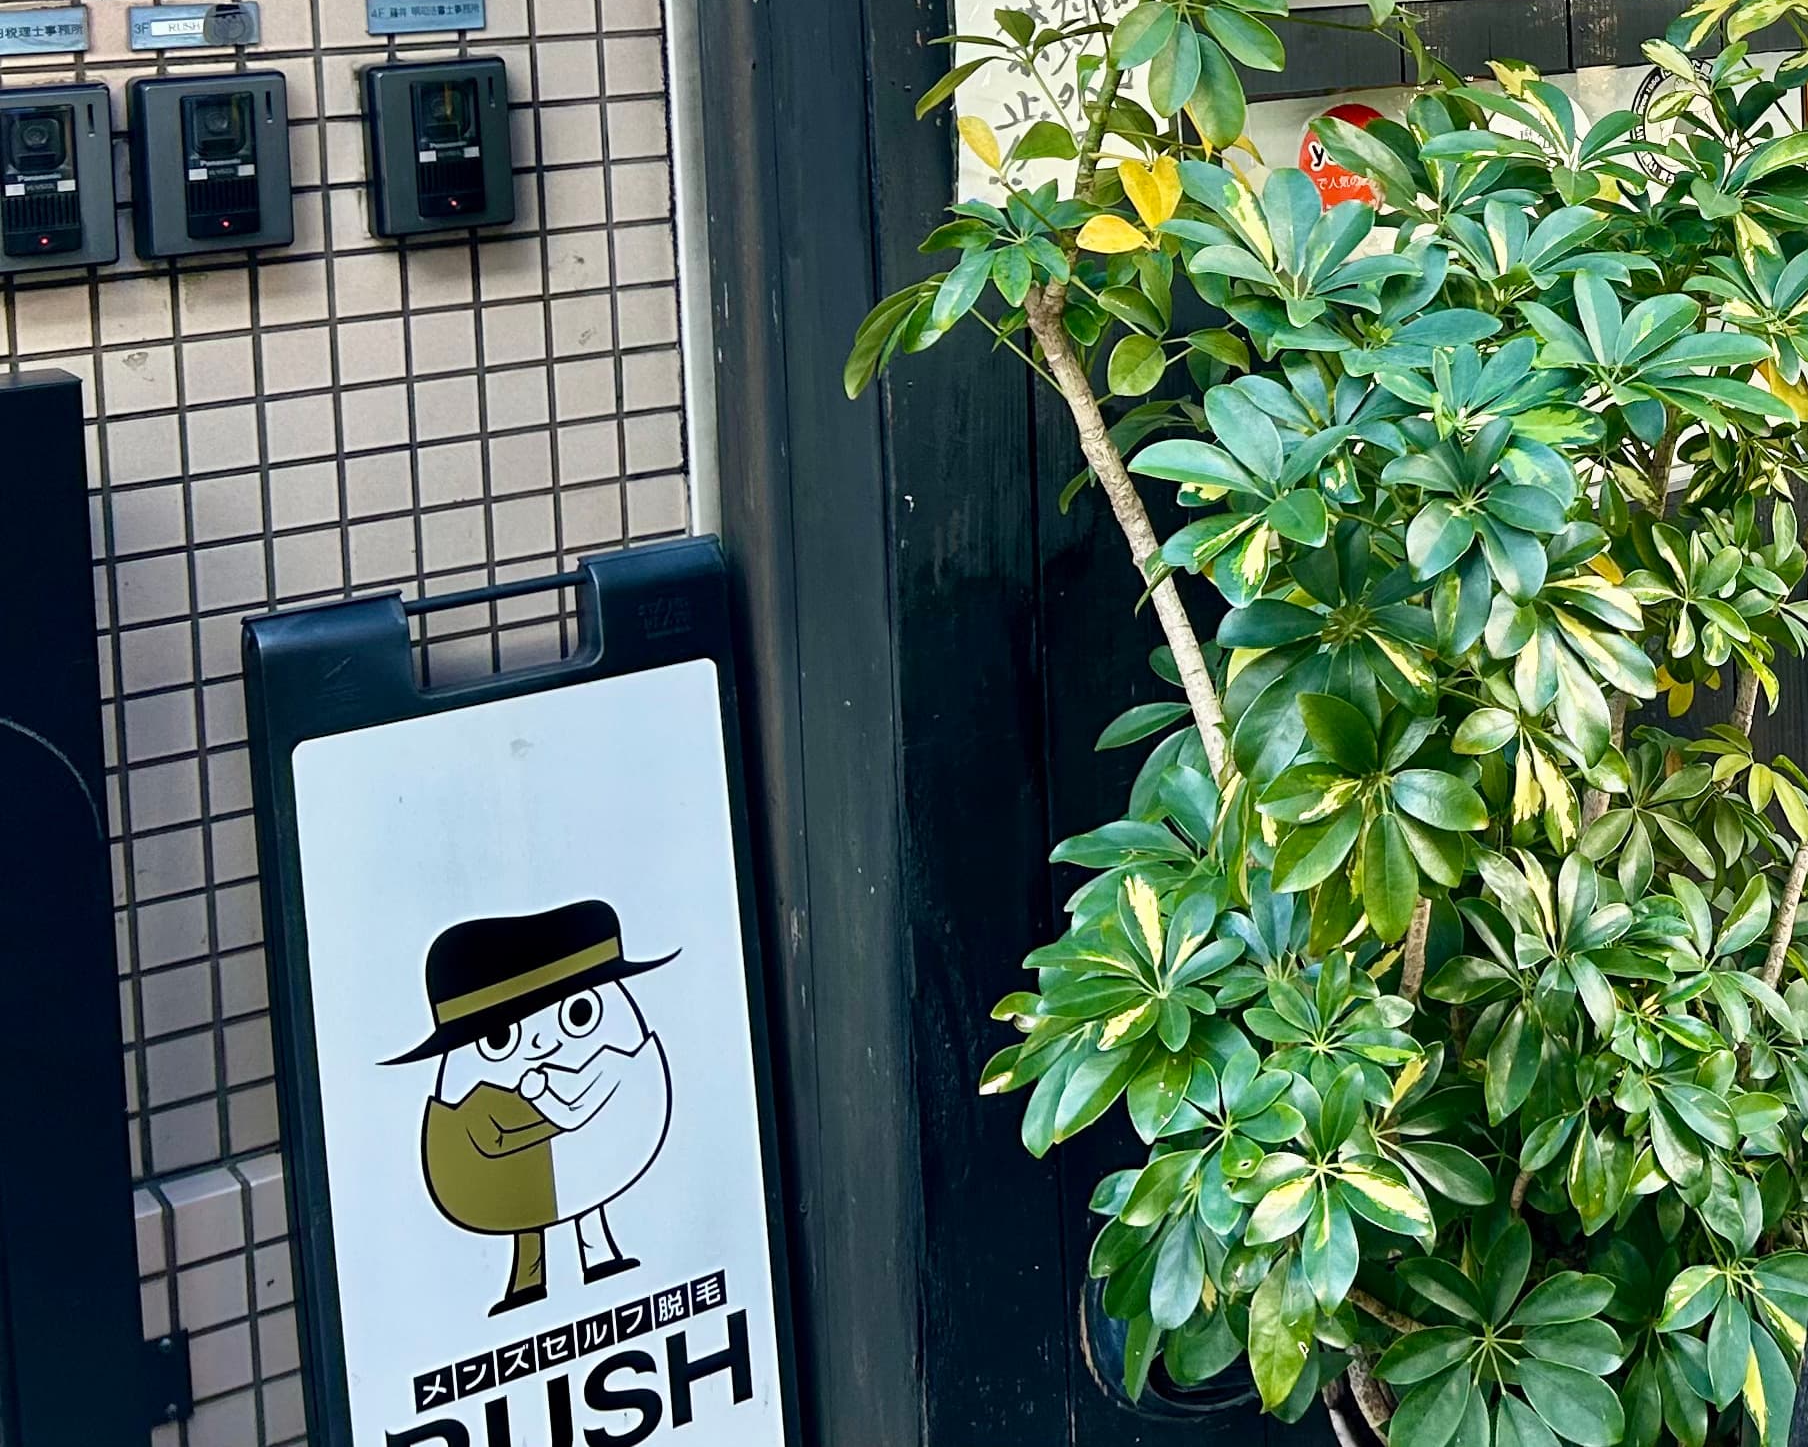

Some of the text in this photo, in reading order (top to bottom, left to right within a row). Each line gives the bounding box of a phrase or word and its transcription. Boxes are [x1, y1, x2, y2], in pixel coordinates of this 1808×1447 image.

[134, 23, 150, 34] 3F
[422, 1277, 721, 1405] メンズセルフ脱毛
